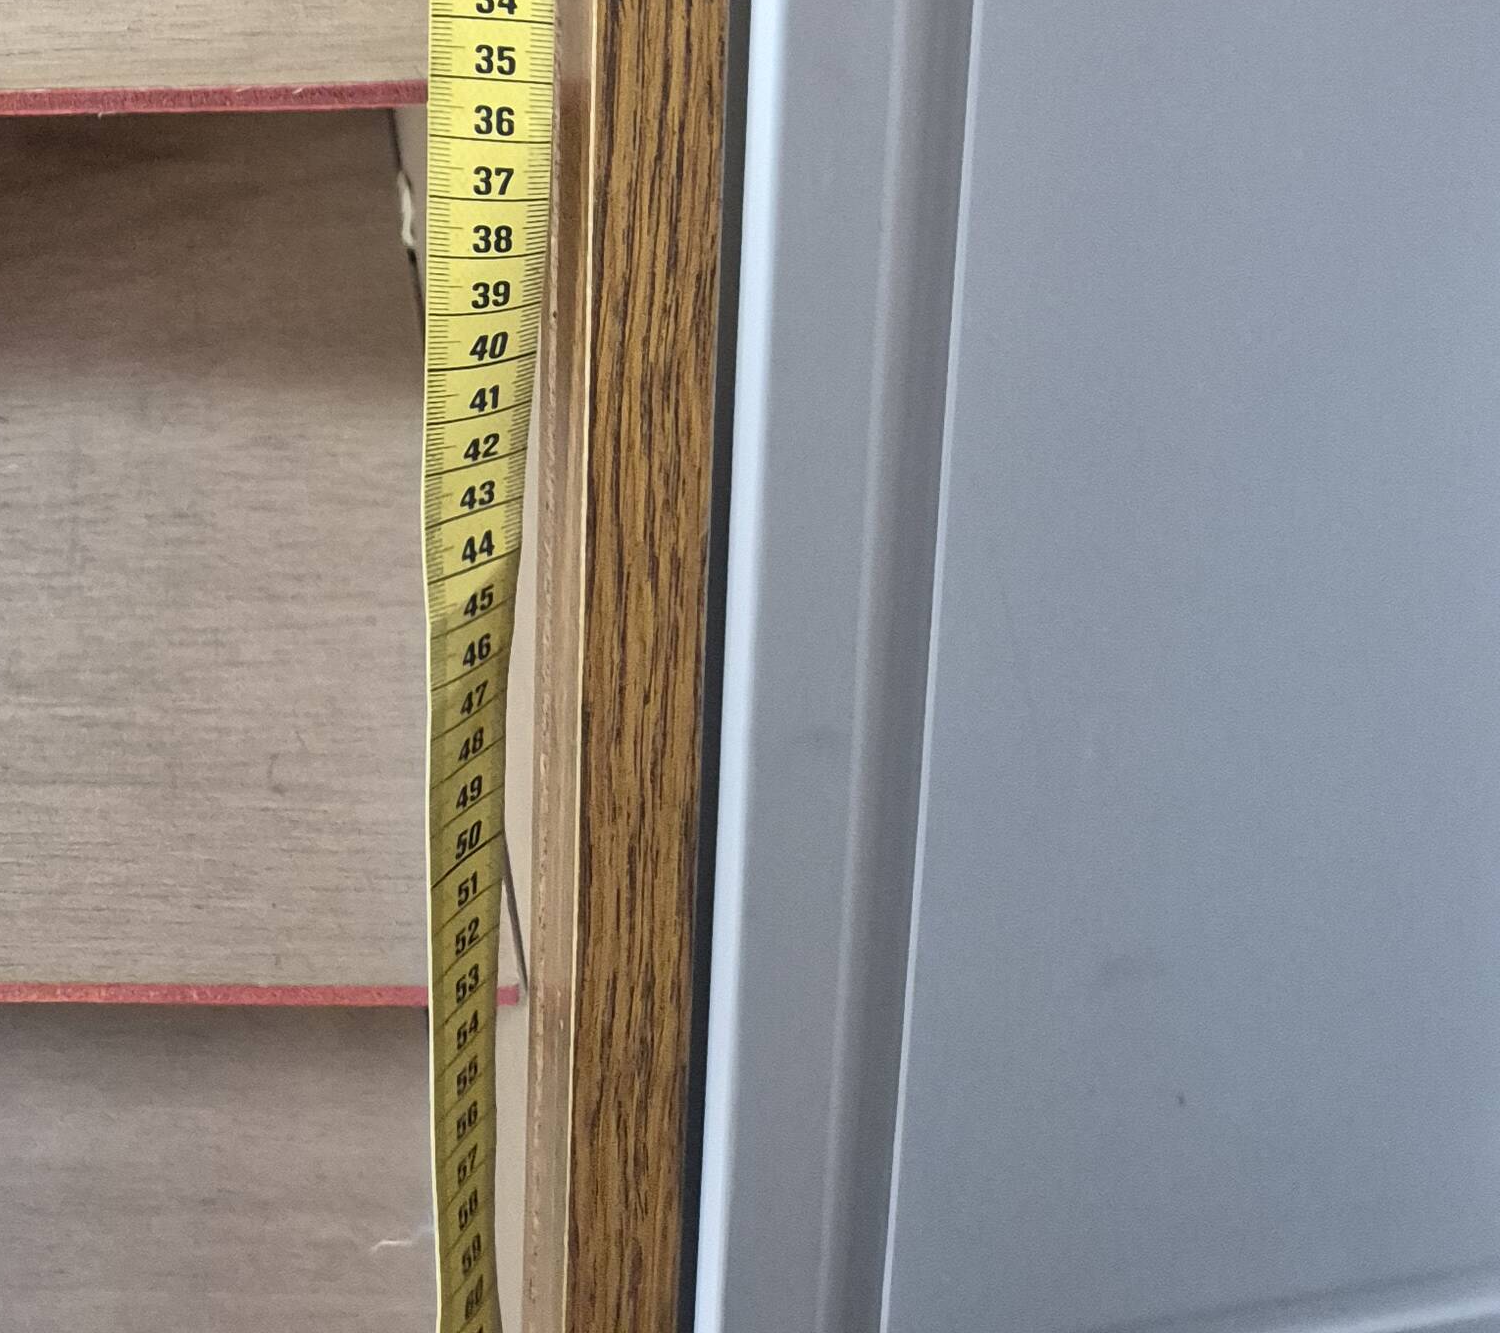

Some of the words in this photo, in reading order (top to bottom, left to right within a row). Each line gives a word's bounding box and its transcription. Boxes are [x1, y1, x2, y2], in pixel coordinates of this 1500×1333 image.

[475, 44, 516, 76] 35
[474, 105, 515, 136] 36
[473, 166, 514, 196] 37
[472, 225, 513, 254] 38
[471, 281, 511, 309] 39
[469, 331, 508, 361] 40
[469, 385, 501, 412] 41
[464, 433, 500, 462] 42
[460, 480, 496, 510] 43
[462, 530, 495, 564] 44
[463, 584, 495, 617] 45
[462, 633, 492, 668] 46
[460, 679, 489, 716] 47
[458, 727, 484, 762] 48
[456, 774, 483, 810] 49
[455, 820, 481, 860] 50
[457, 870, 479, 907] 51
[455, 916, 480, 956] 52
[456, 964, 480, 1004] 53
[456, 1010, 479, 1051] 54
[456, 1055, 479, 1096] 55
